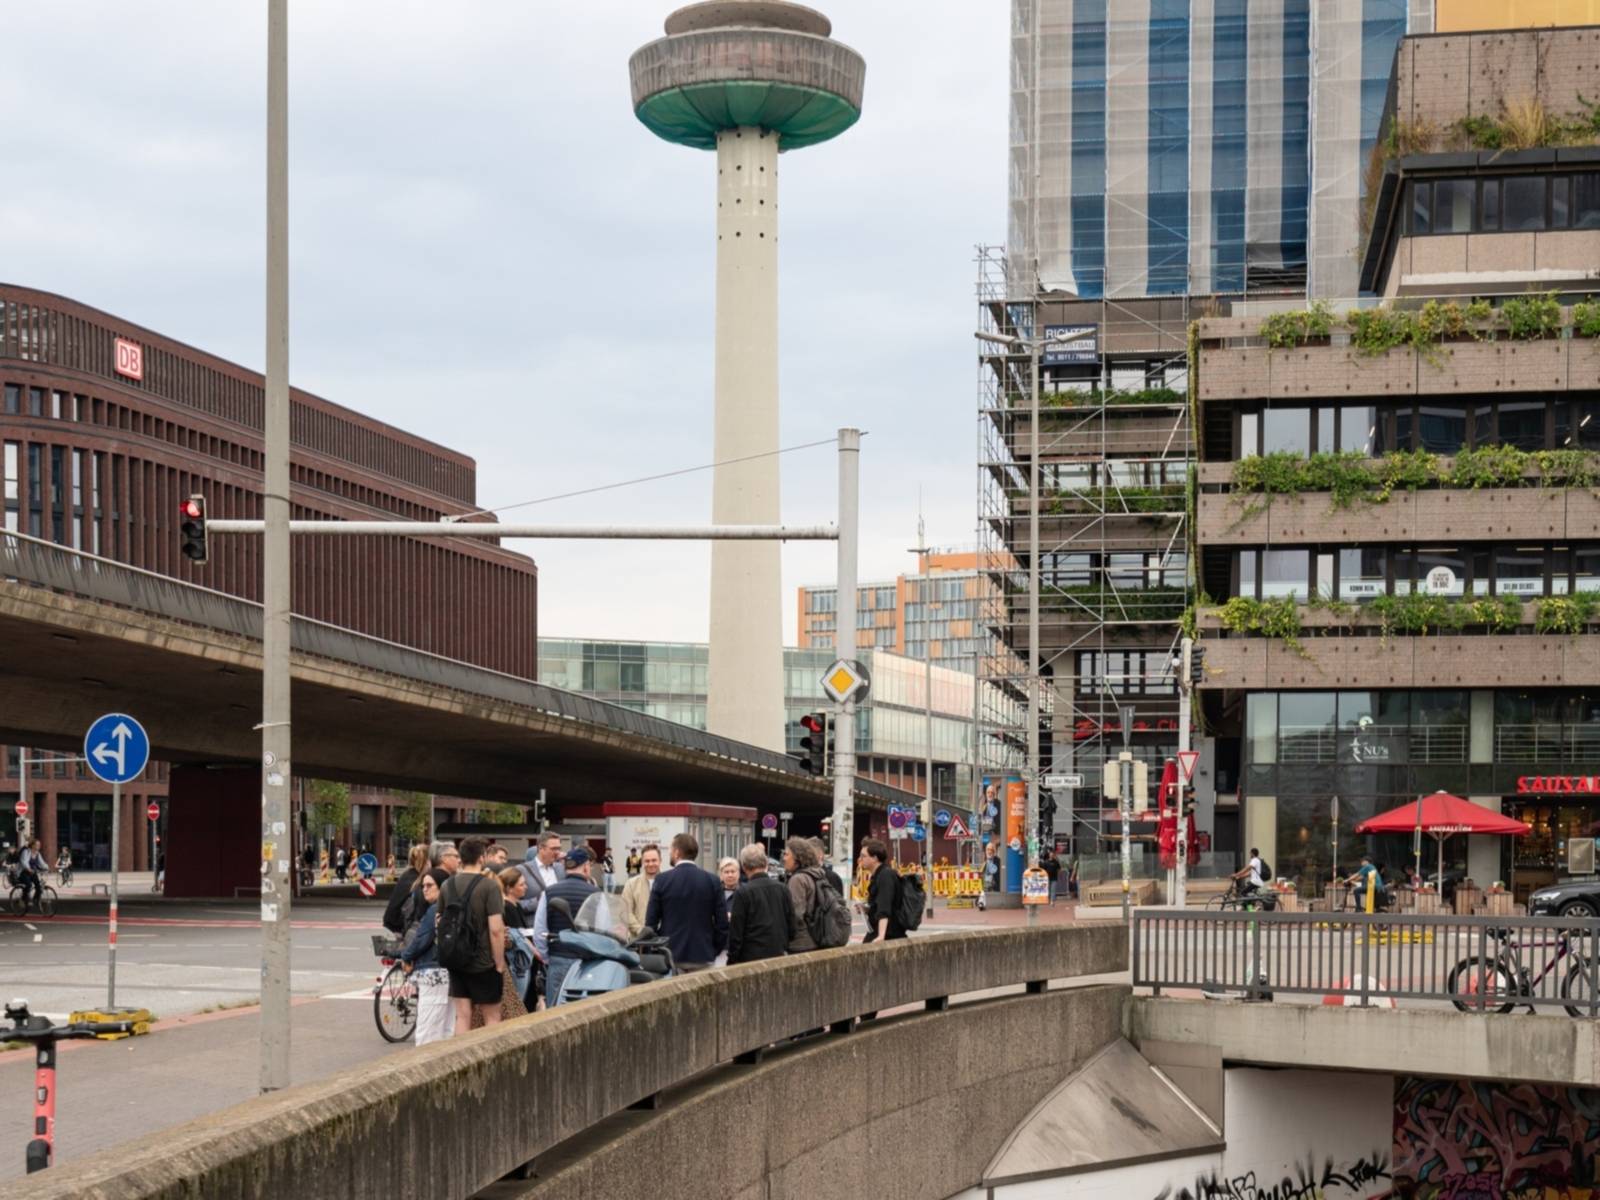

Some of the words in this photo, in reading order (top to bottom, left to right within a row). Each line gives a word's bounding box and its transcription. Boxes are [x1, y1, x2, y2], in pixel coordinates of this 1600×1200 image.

[1046, 328, 1095, 339] RICHT
[120, 345, 139, 372] DB
[1517, 776, 1600, 793] SAUSAL
